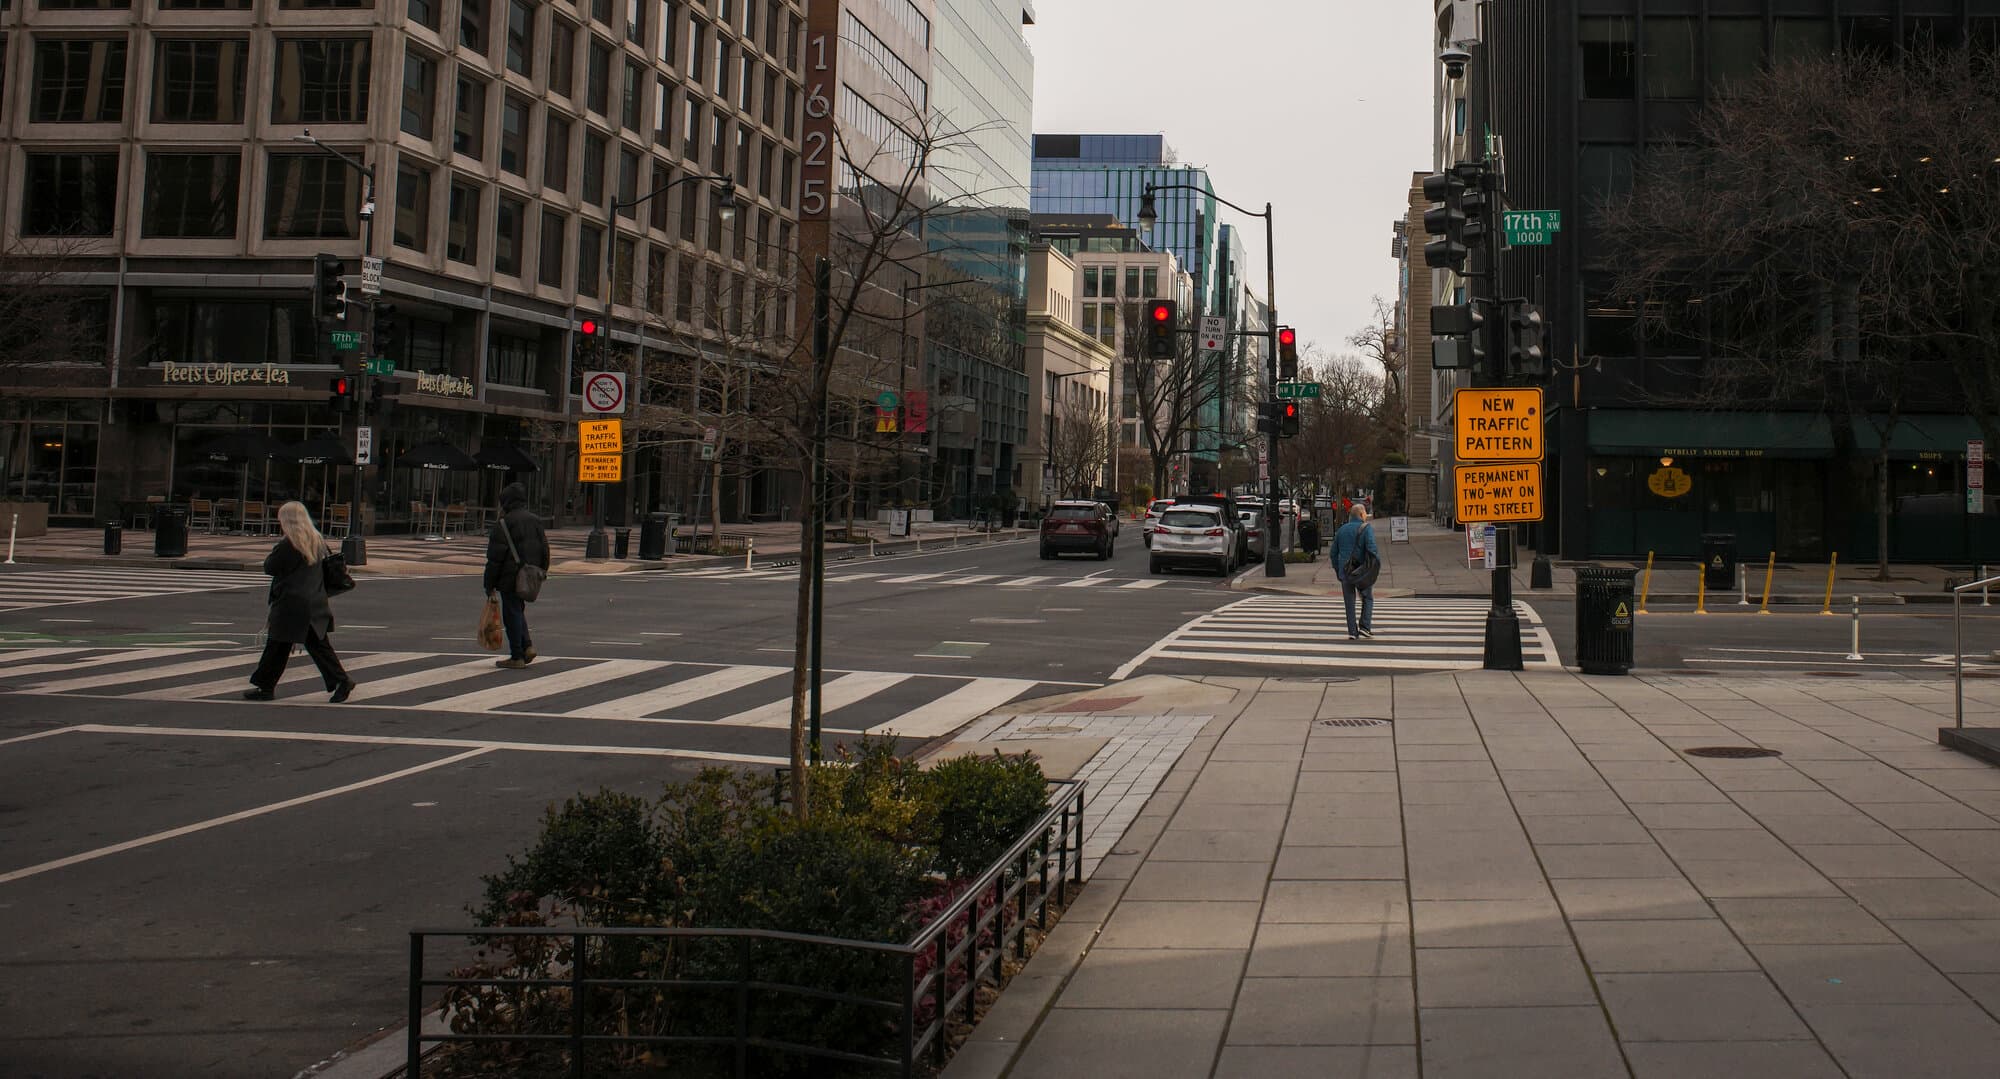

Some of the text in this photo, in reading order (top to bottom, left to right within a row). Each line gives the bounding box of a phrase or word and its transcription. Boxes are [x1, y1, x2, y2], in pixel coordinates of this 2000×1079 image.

[803, 35, 829, 215] 1625
[1504, 213, 1542, 230] 17th
[1546, 222, 1560, 230] NW
[1517, 232, 1542, 243] 1000
[363, 260, 381, 270] DO NOT
[363, 272, 379, 282] BLOCK
[332, 333, 352, 342] 17th
[204, 361, 249, 386] Coffee
[250, 368, 265, 381] &
[263, 362, 289, 385] Tea
[376, 360, 383, 374] L
[436, 373, 457, 396] Coffee
[462, 376, 474, 397] Tea
[1482, 398, 1515, 412] NEW
[1468, 417, 1529, 431] TRAFFIC
[585, 433, 616, 441] TRAFFIC
[1466, 437, 1532, 450] PATTERN
[585, 442, 617, 450] PATTERN
[1704, 448, 1740, 456] SANDWICH
[1465, 470, 1530, 483] PERMANENT
[1463, 486, 1534, 500] TWO-WAY ON
[1464, 502, 1534, 516] 17TH STREET
